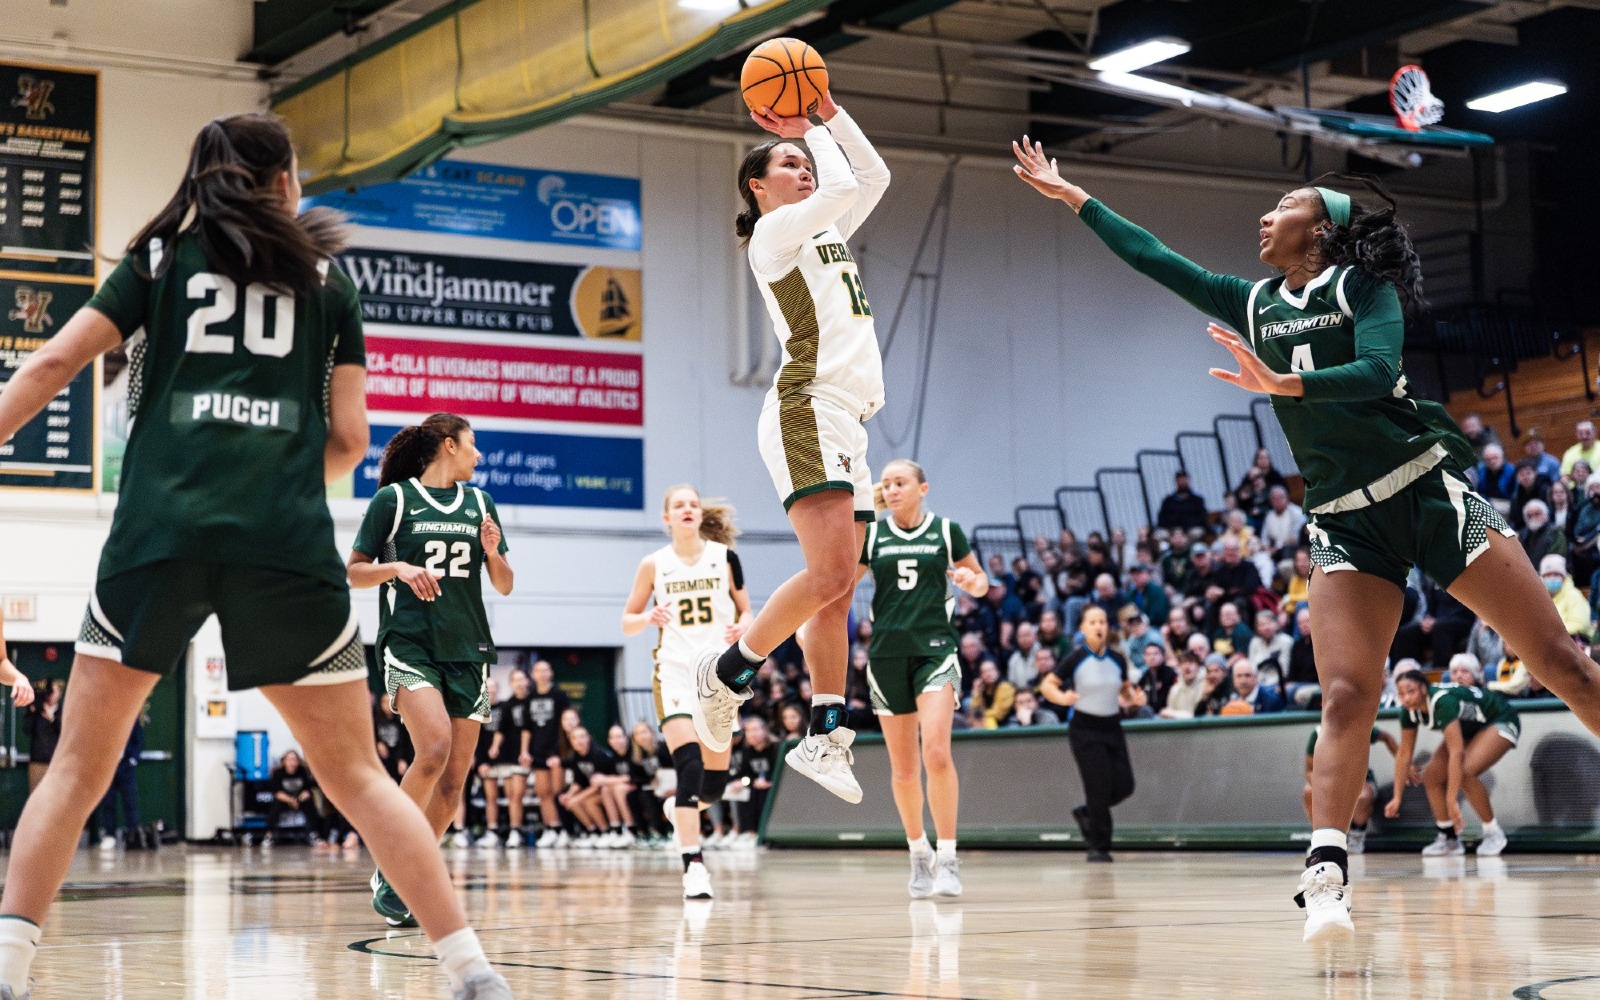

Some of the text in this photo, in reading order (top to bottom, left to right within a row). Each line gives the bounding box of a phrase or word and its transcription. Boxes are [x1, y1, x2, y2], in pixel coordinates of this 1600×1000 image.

[17, 124, 91, 143] BASKETBALL
[343, 256, 555, 307] Windjammer
[185, 272, 295, 358] 20
[362, 302, 554, 331] ND UPPER DECK PUB
[1260, 313, 1344, 341] BINGHAMTON
[366, 352, 640, 389] CA-COLA BEVERAGES NORTHEAST IS A PROUD
[1290, 343, 1316, 373] 4
[366, 375, 640, 411] RTNER OF UNIVERSITY OF VERMONT ATHLETICS
[192, 393, 280, 426] PUCCI
[414, 523, 478, 537] BINGHAMTON
[425, 540, 471, 579] 22
[897, 558, 918, 590] 5
[664, 578, 721, 594] VERMONT
[678, 596, 713, 626] 25
